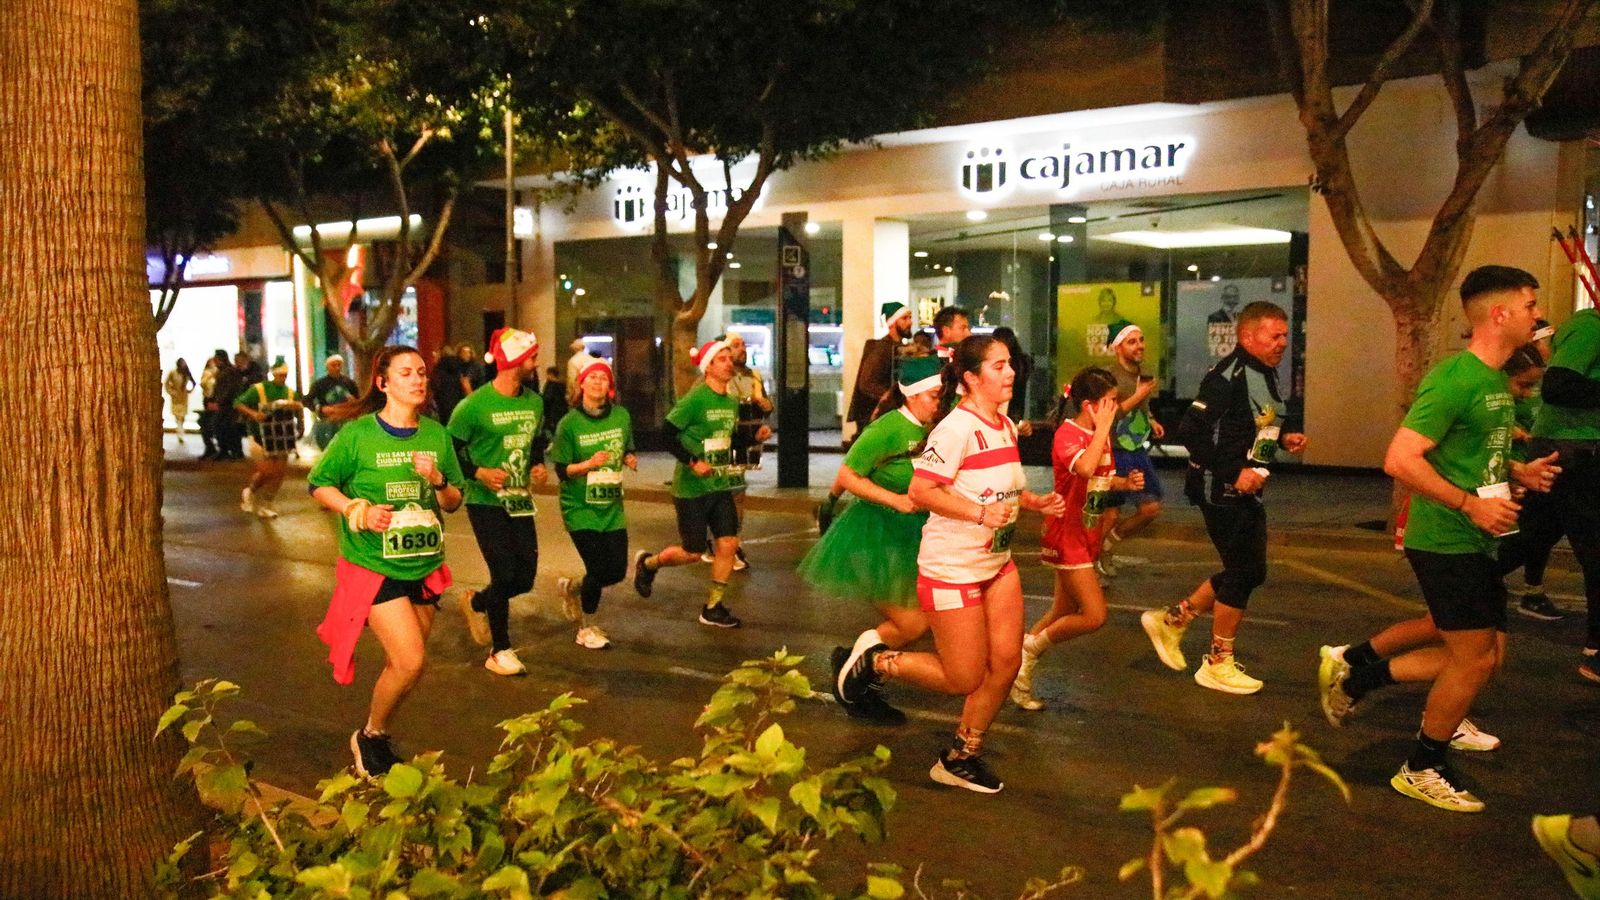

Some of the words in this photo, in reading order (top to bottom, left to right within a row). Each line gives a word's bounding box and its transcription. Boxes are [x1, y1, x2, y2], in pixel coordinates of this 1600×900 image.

[1020, 142, 1185, 189] cajamar
[1208, 325, 1236, 334] PENS
[376, 457, 402, 466] CIUDAD
[389, 531, 439, 551] 1630
